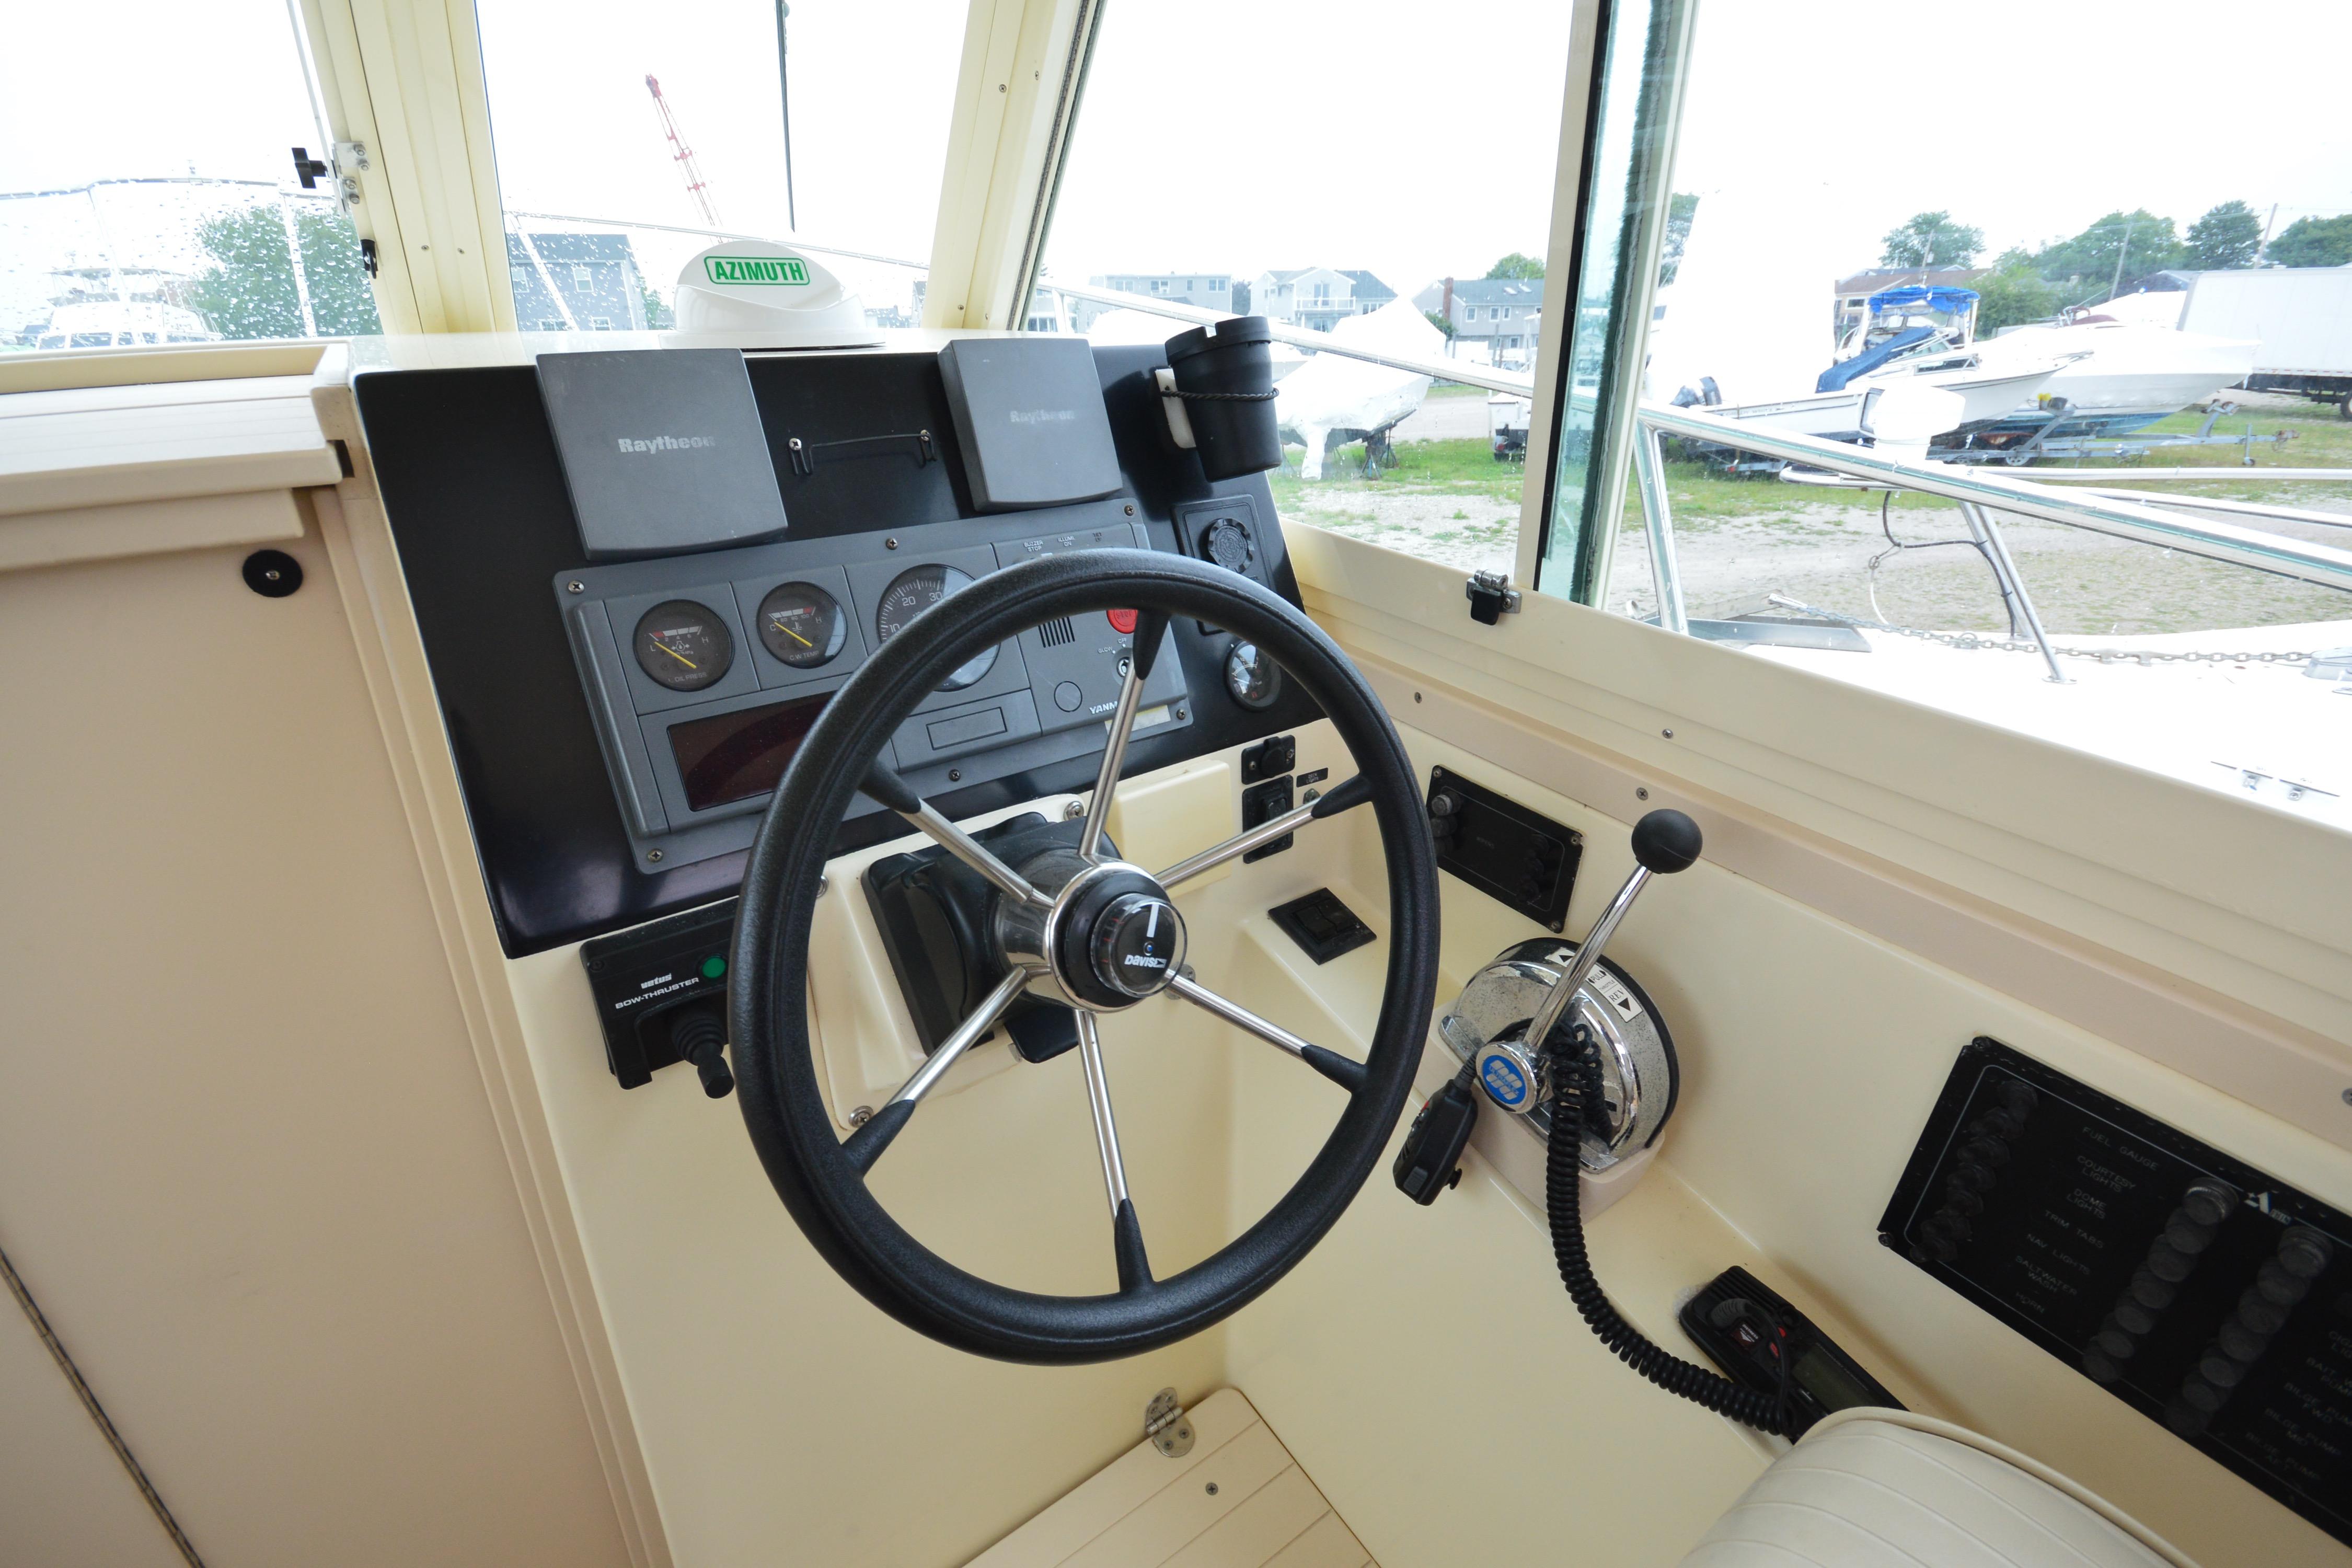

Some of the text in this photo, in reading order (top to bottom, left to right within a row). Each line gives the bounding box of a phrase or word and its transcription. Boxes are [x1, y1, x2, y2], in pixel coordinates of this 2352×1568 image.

[714, 261, 804, 281] AZIMUTH
[618, 436, 716, 454] Raytheon
[902, 591, 942, 606] 20 30
[890, 623, 900, 633] 10
[640, 973, 672, 989] vetus
[1591, 972, 1603, 983] PULL
[1599, 979, 1616, 991] THROTTLE
[615, 977, 699, 1009] BOW-THRUSTER
[1608, 988, 1625, 1002] REV
[2082, 1126, 2159, 1171] FUEL GAUGE
[2076, 1155, 2137, 1190] COURTESY
[2081, 1167, 2123, 1193] LIGHTS
[2066, 1193, 2106, 1219] LIGHTS
[2073, 1187, 2107, 1210] DOME
[2044, 1209, 2104, 1249] TRIM TABS
[2026, 1233, 2091, 1275] NAV LIGHTS
[2015, 1254, 2078, 1296] SALTWATER
[2027, 1271, 2058, 1294] WASH
[2015, 1291, 2046, 1314] HORN
[2264, 1406, 2343, 1456] BILGE PUMP
